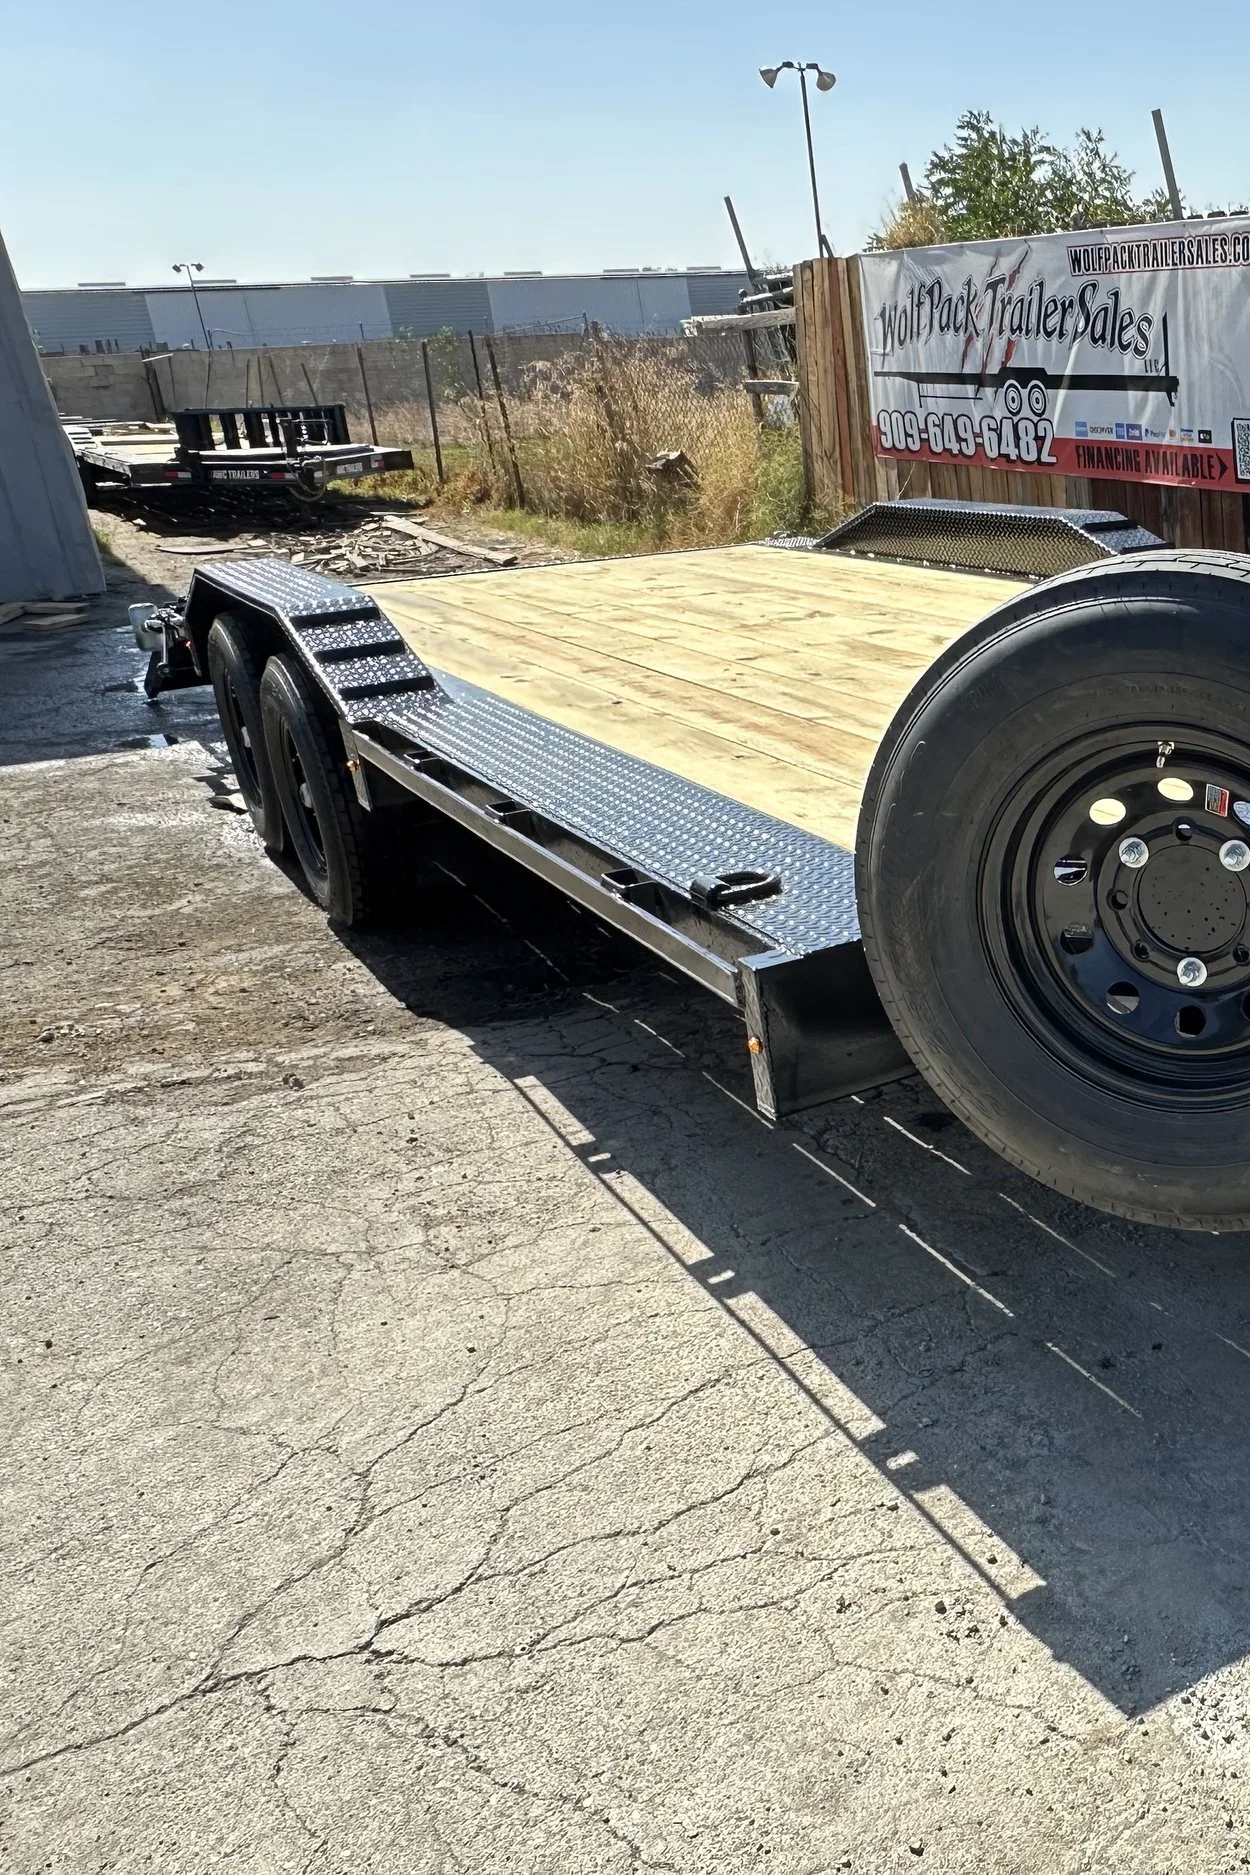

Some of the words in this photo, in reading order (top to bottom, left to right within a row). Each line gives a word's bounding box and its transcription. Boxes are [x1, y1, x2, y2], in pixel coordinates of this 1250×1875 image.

[1144, 359, 1160, 374] LLC
[877, 410, 1058, 464] 909-649-6482
[1075, 445, 1141, 472] FINANCING
[1145, 450, 1216, 480] AVAILABLE
